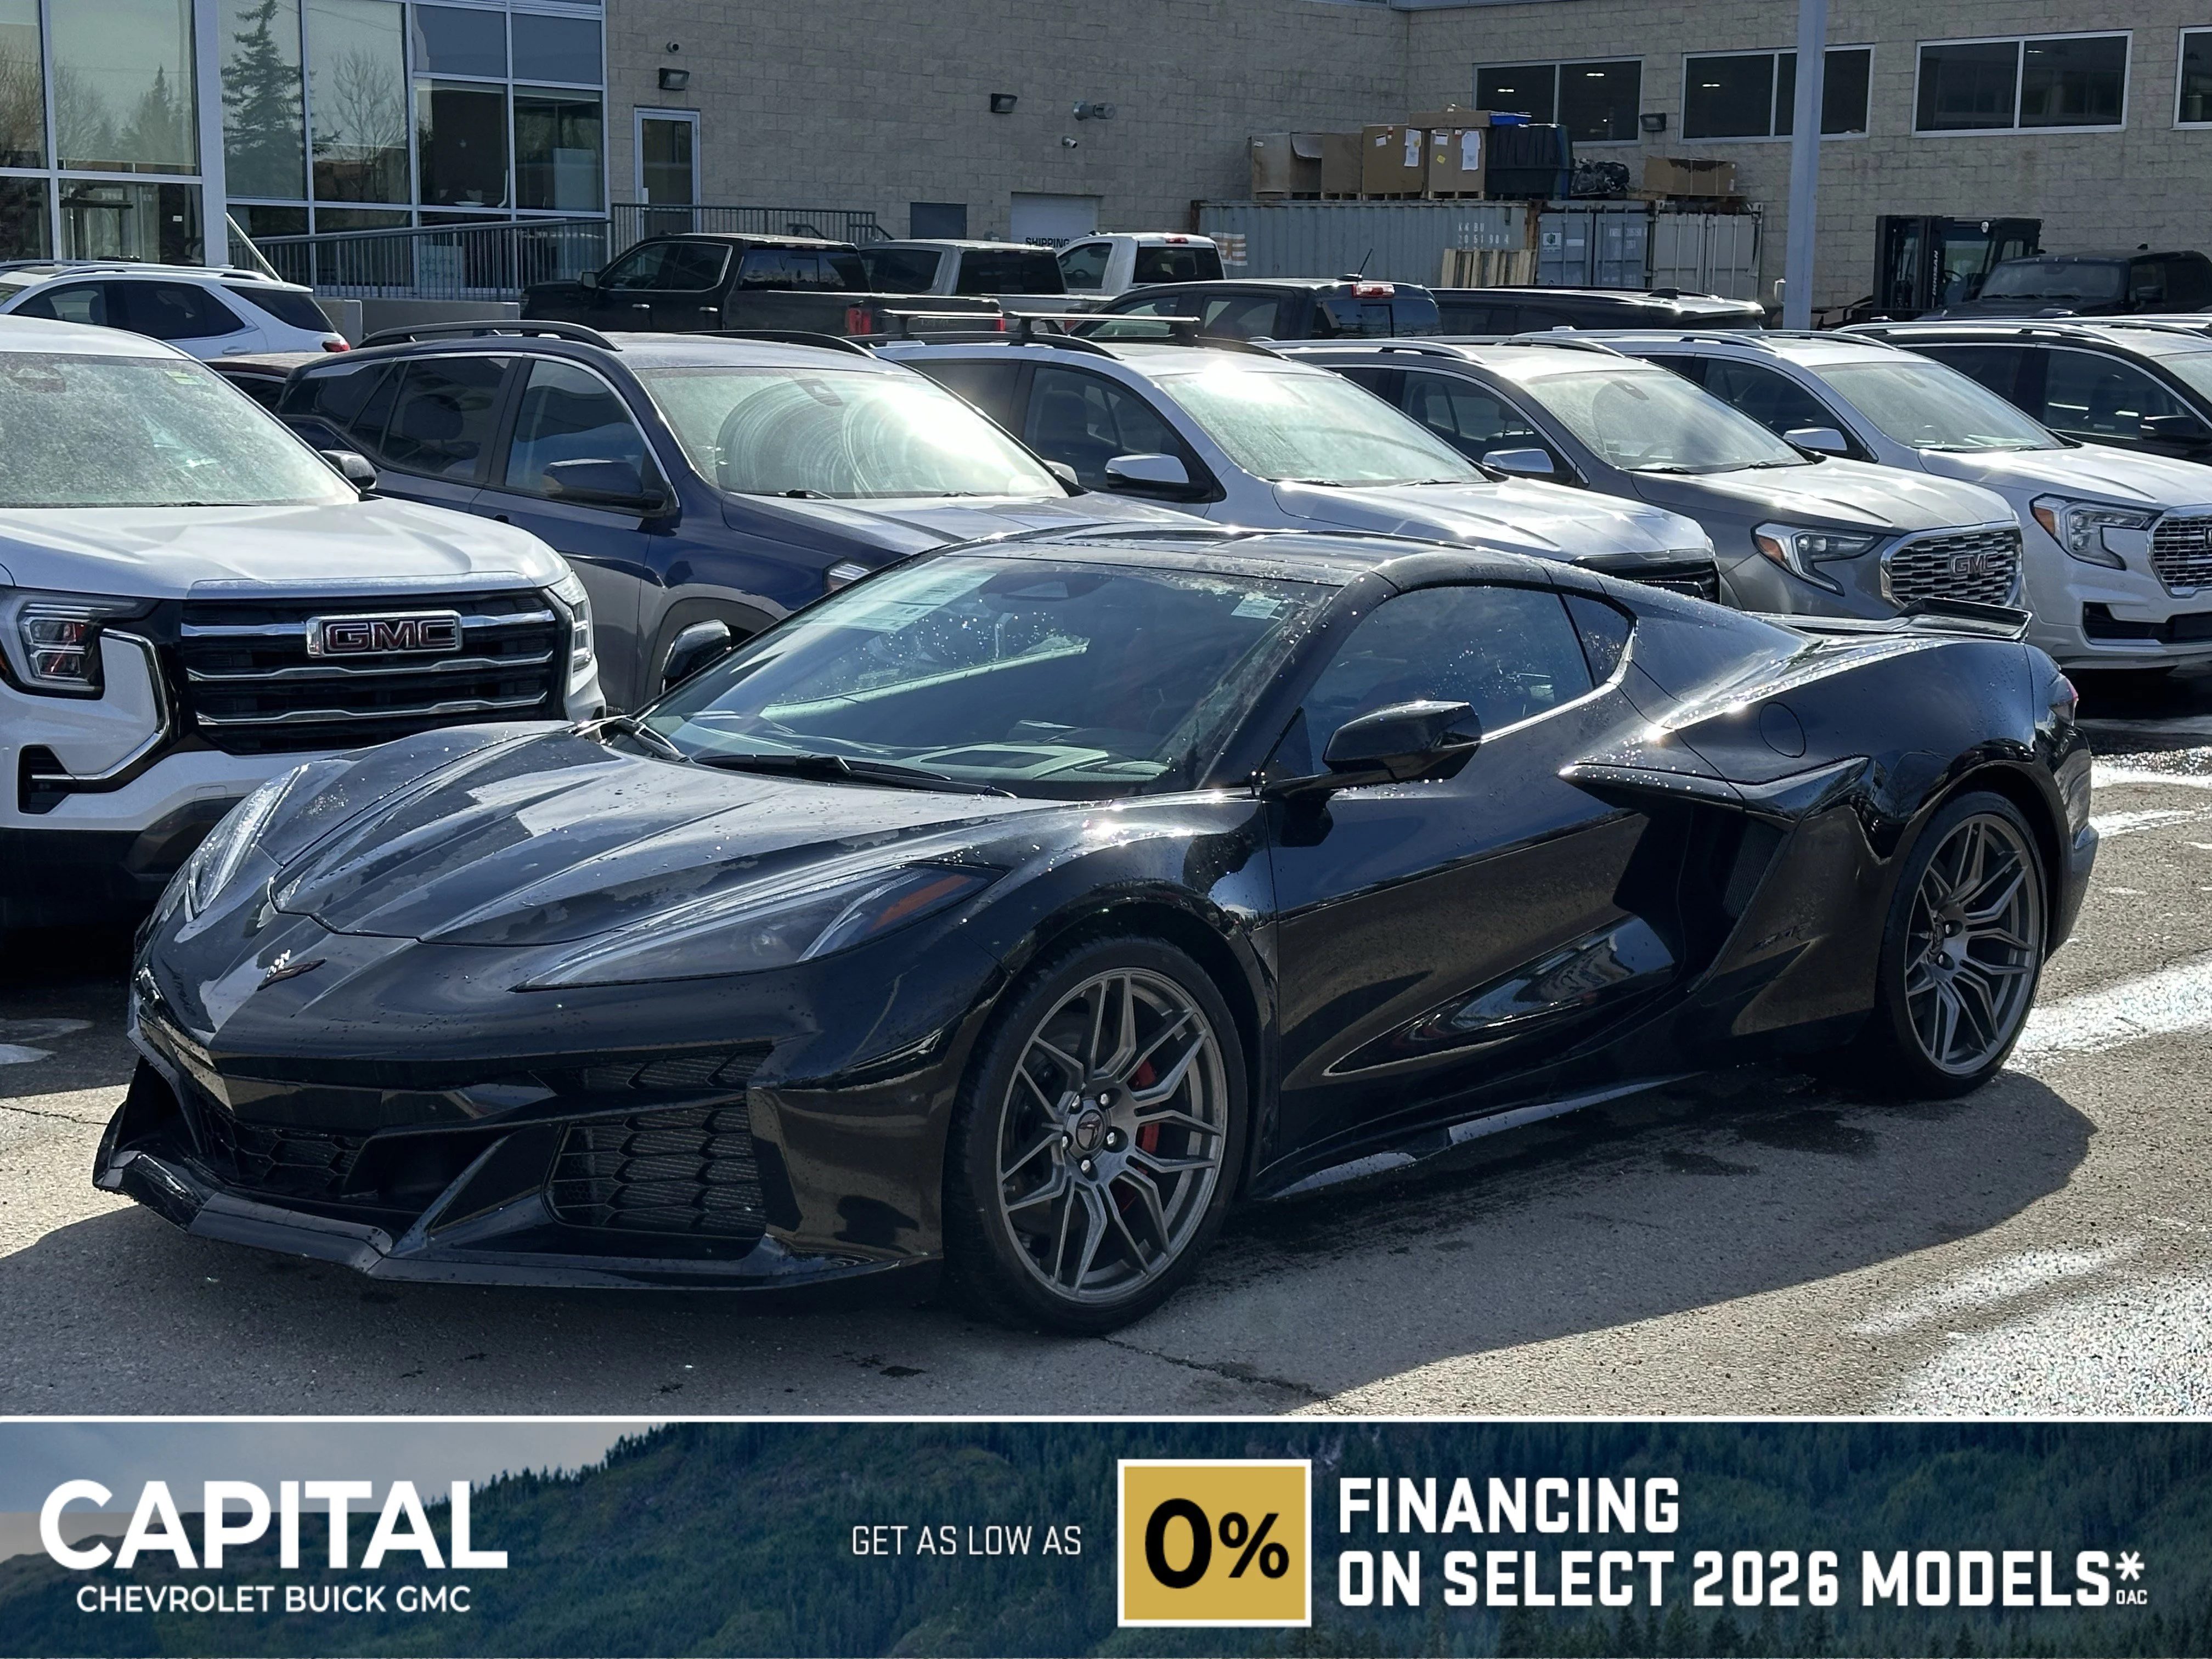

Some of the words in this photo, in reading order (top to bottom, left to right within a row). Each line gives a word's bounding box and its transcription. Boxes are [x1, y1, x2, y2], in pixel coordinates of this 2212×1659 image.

[1025, 237, 1070, 248] SHIPPING
[1952, 554, 1998, 576] GMC
[325, 618, 456, 652] GMC
